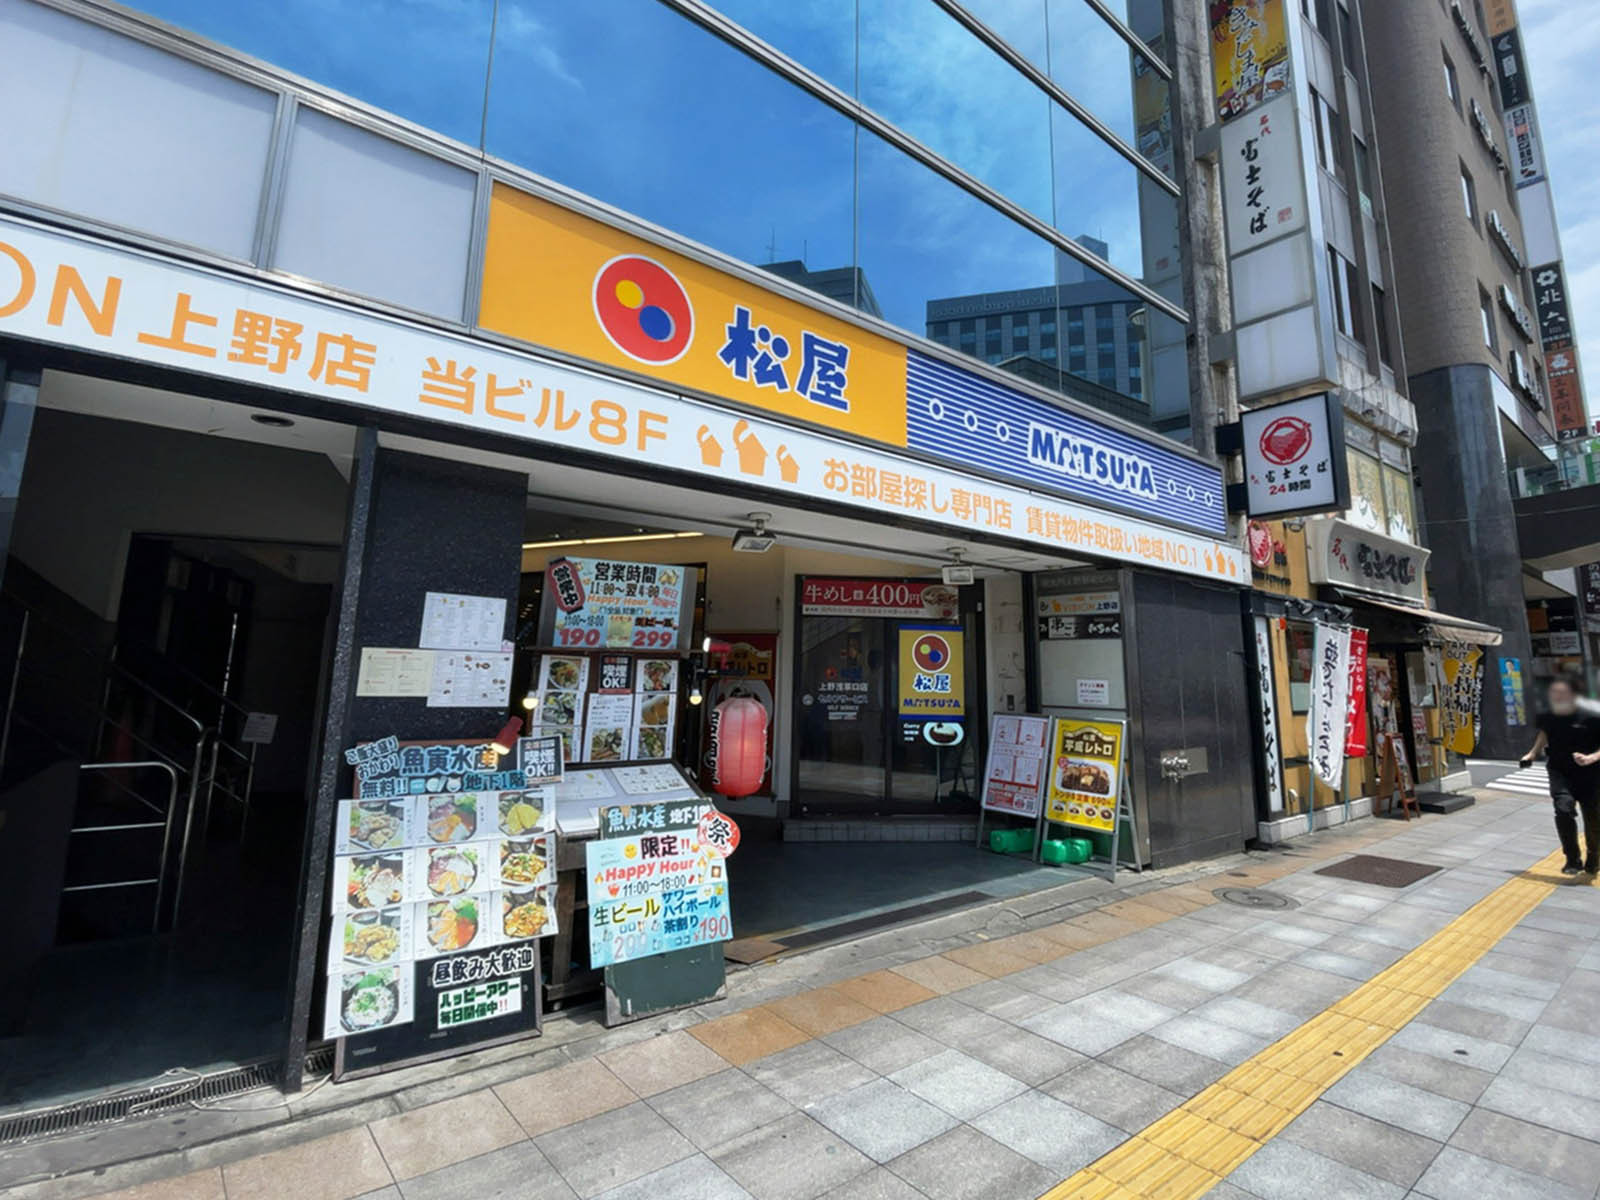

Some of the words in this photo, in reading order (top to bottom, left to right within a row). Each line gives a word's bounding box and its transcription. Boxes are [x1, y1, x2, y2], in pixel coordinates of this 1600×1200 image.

[137, 292, 377, 393] 上野店
[718, 304, 850, 413] 松屋
[418, 356, 670, 451] 当ビル8F
[1028, 423, 1158, 500] MATSUYA
[822, 458, 1012, 530] お部屋探し専門店
[1269, 480, 1311, 495] 24時間
[594, 561, 657, 584] 営業時間
[805, 584, 852, 603] 牛めし
[559, 628, 601, 647] 190
[632, 631, 673, 648] 299
[913, 672, 952, 692] 松屋
[903, 698, 960, 709] MATSUYA
[1064, 739, 1113, 756] 平成レトロ
[402, 745, 499, 776] 魚寅水産
[708, 817, 731, 845] 祭
[605, 861, 656, 882] Happy
[659, 858, 695, 874] Hour
[662, 889, 697, 904] サワー
[663, 896, 721, 919] ハイボール
[594, 898, 661, 928] 生ビール
[664, 915, 699, 934] 茶割り
[434, 948, 534, 986] 昼飲み大歓迎
[440, 981, 520, 1009] ハッピーアワー
